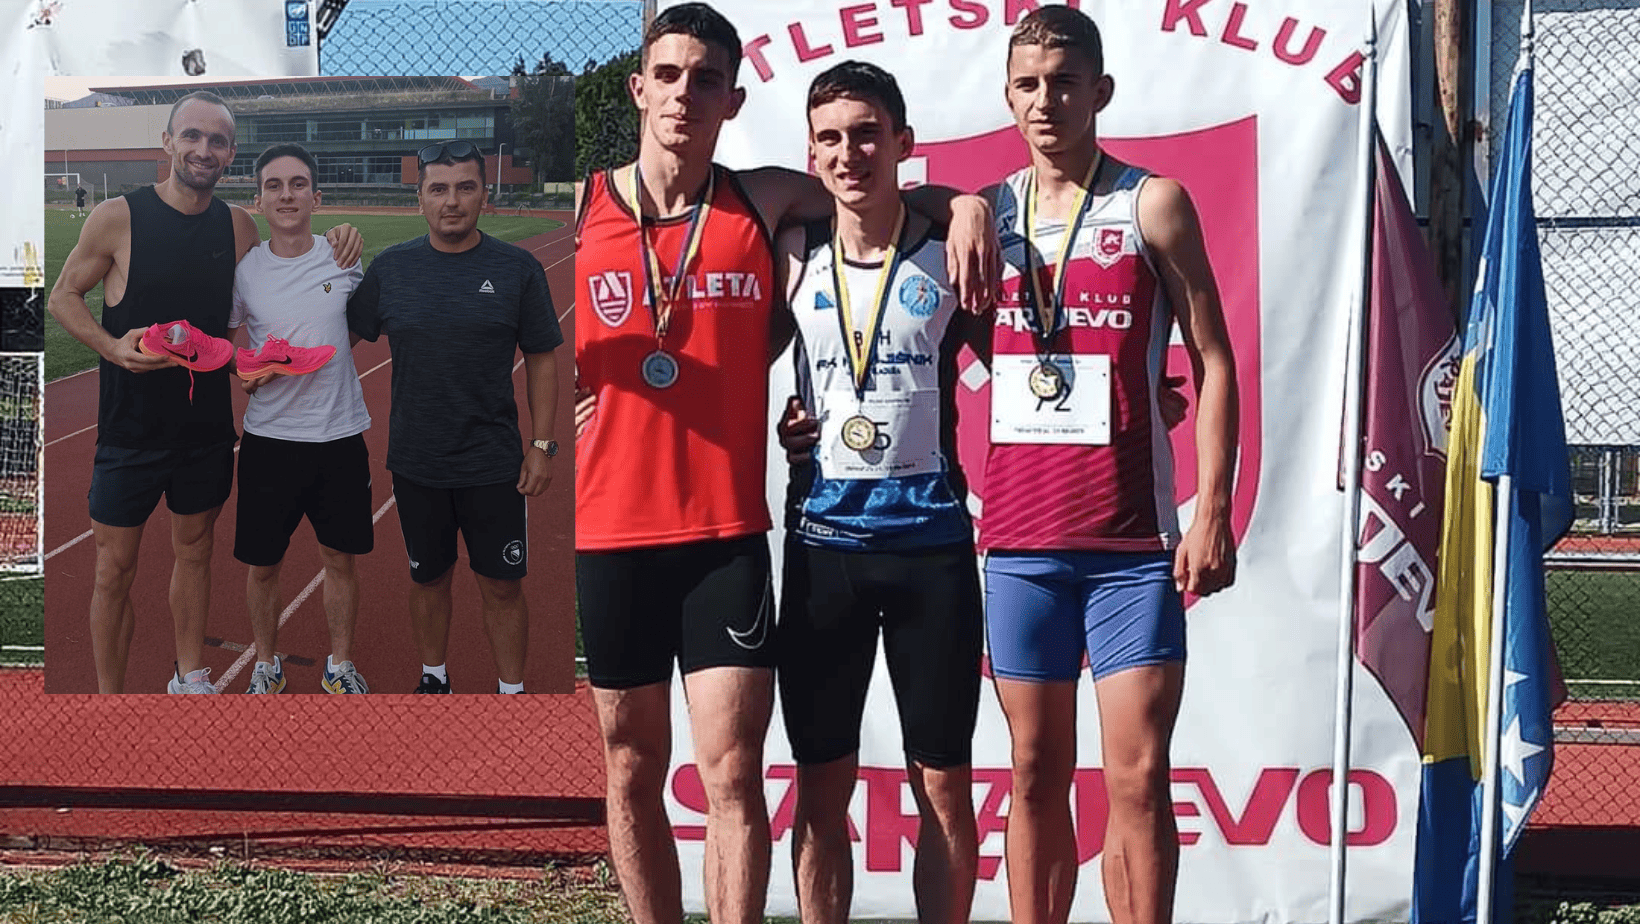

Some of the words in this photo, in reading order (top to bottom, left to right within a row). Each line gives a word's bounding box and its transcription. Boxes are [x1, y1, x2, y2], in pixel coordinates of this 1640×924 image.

[741, 0, 1080, 83] TLETSK
[1079, 291, 1131, 304] KLUB
[994, 307, 1133, 332] ARJEVO
